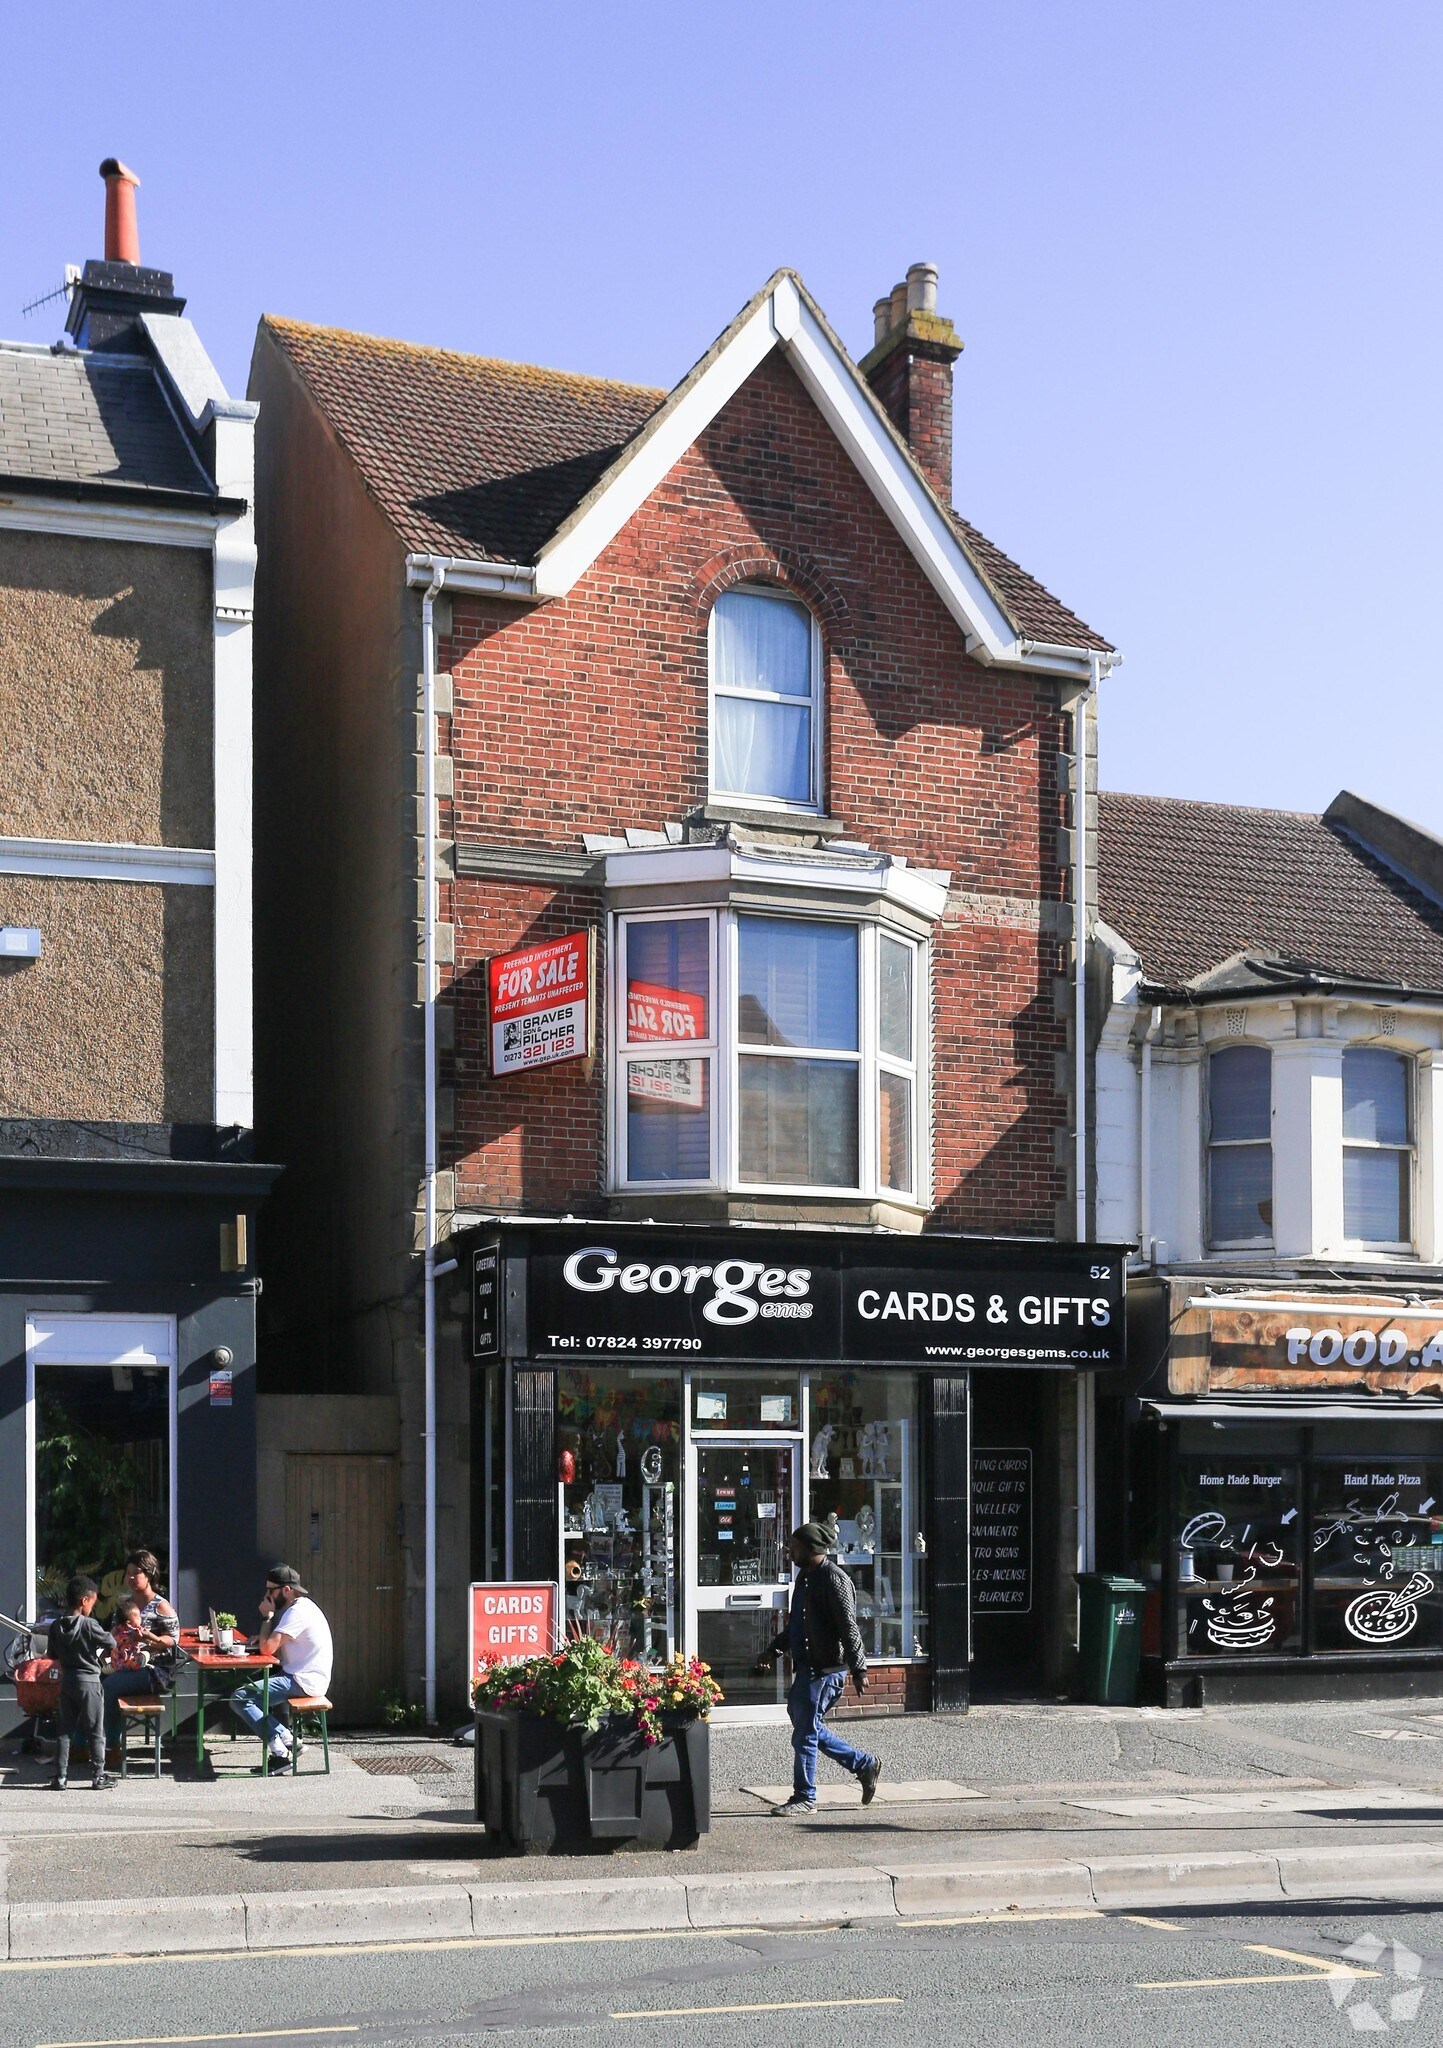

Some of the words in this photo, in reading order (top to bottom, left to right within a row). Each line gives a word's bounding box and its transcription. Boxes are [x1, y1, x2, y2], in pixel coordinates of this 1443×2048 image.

[504, 955, 533, 970] FREEHOLD
[534, 942, 573, 960] INVESTMENT
[498, 967, 533, 1000] FOR
[536, 952, 579, 989] SALE
[494, 1000, 521, 1014] PRESENT
[521, 992, 546, 1006] TENANTS
[548, 982, 584, 998] UNAFFECTED
[523, 1007, 573, 1029] GRAVES
[523, 1028, 537, 1036] SON
[523, 1024, 575, 1046] PILCHER
[504, 1052, 522, 1063] 01273
[523, 1044, 546, 1059] 321
[552, 1036, 575, 1052] 123
[523, 1050, 575, 1066] www.gsp.uk.com
[476, 1256, 495, 1272] GREETING
[1090, 1266, 1111, 1280] 52
[480, 1282, 492, 1296] CARDS
[563, 1246, 812, 1325] Georges
[857, 1290, 976, 1320] CARDS
[986, 1294, 1009, 1324] &
[1019, 1296, 1110, 1326] GIFTS
[480, 1332, 491, 1345] GIFTS
[548, 1335, 580, 1348] Tel:
[586, 1336, 637, 1349] 07824
[642, 1337, 702, 1350] 397790
[926, 1346, 1110, 1359] www.georgesgems.co.uk
[974, 1460, 996, 1471] TING
[998, 1460, 1028, 1471] CARDS
[1200, 1475, 1224, 1485] Home
[1228, 1475, 1250, 1485] Made
[1253, 1475, 1282, 1487] Burger
[1344, 1474, 1368, 1485] Hand
[1372, 1475, 1395, 1485] Made
[1398, 1475, 1421, 1485] Pizza
[972, 1482, 996, 1493] IQUE
[999, 1482, 1026, 1492] GIFTS
[974, 1504, 1022, 1515] WELLERY
[974, 1548, 992, 1558] TRO
[995, 1548, 1019, 1558] SIGNS
[973, 1569, 1027, 1580] LES-INCENSE
[974, 1592, 1025, 1603] -BURNERS
[484, 1596, 543, 1615] CARDS
[489, 1625, 539, 1644] GIFTS
